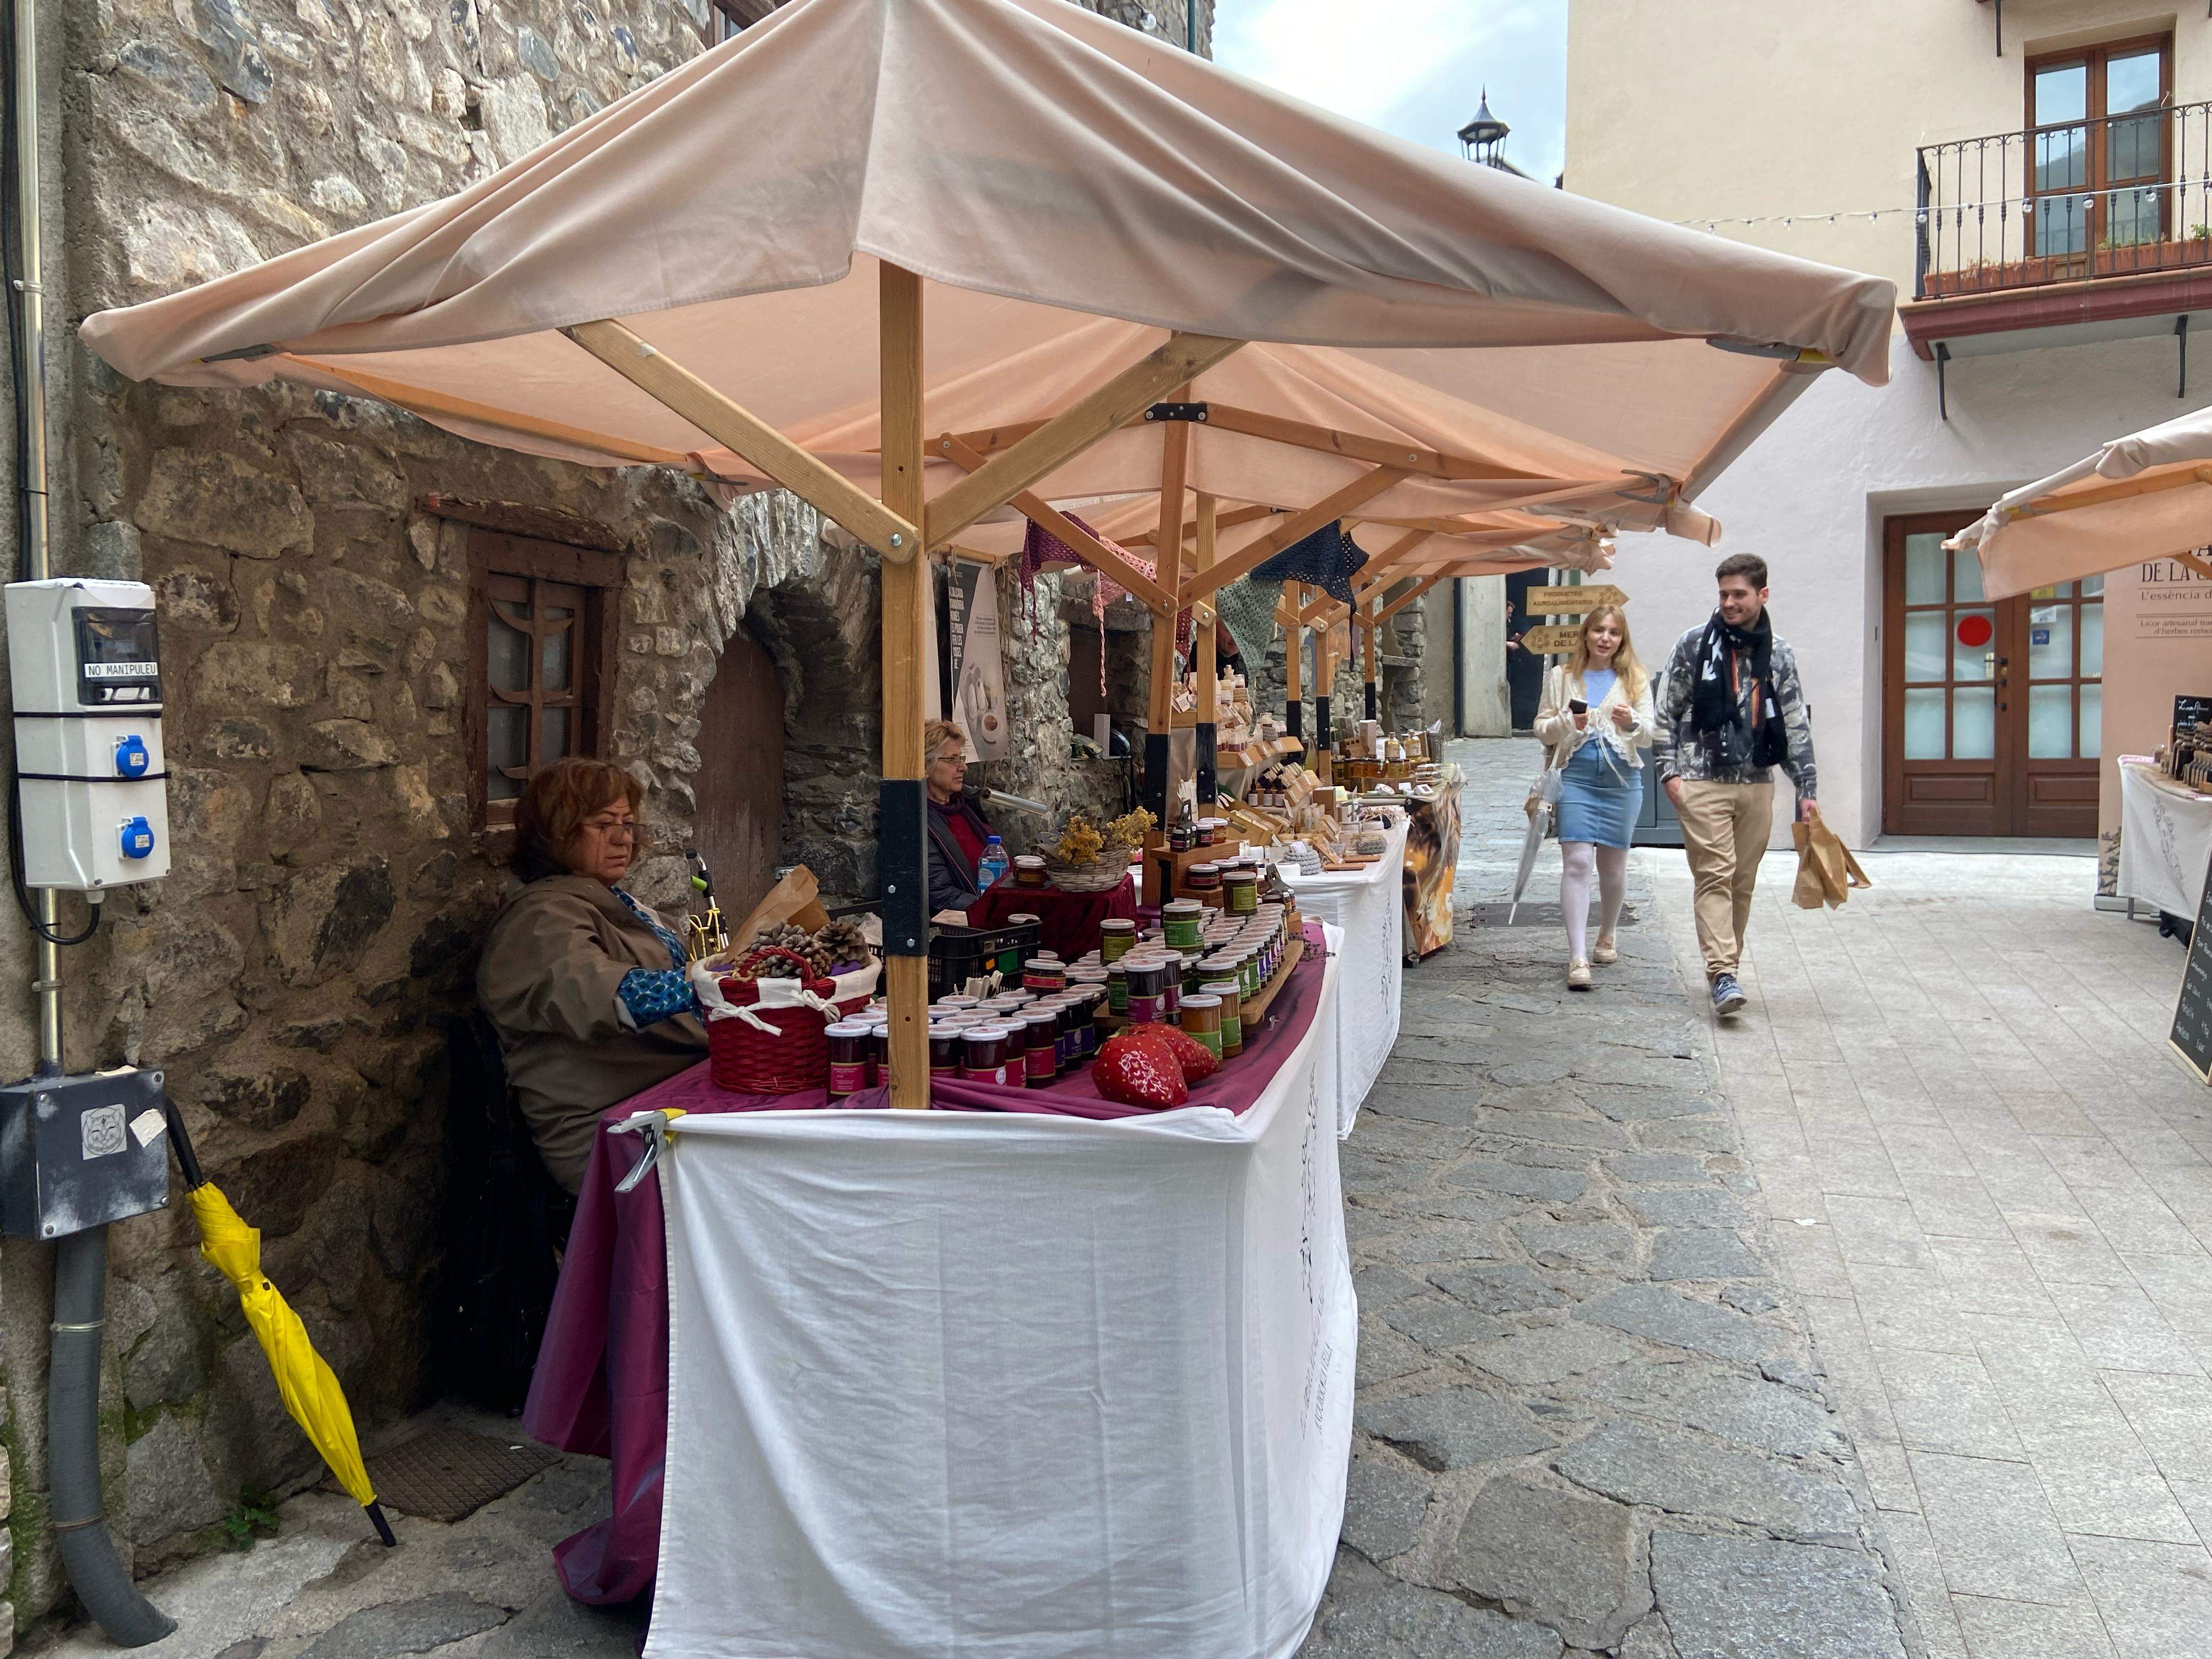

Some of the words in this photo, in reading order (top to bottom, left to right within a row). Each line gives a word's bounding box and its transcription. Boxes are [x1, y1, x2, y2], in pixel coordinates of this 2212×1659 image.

[2142, 563, 2163, 582] DE
[2169, 562, 2190, 582] LA
[2141, 589, 2199, 600] L'essència
[88, 665, 101, 676] NO
[106, 663, 156, 675] MANIPULEU
